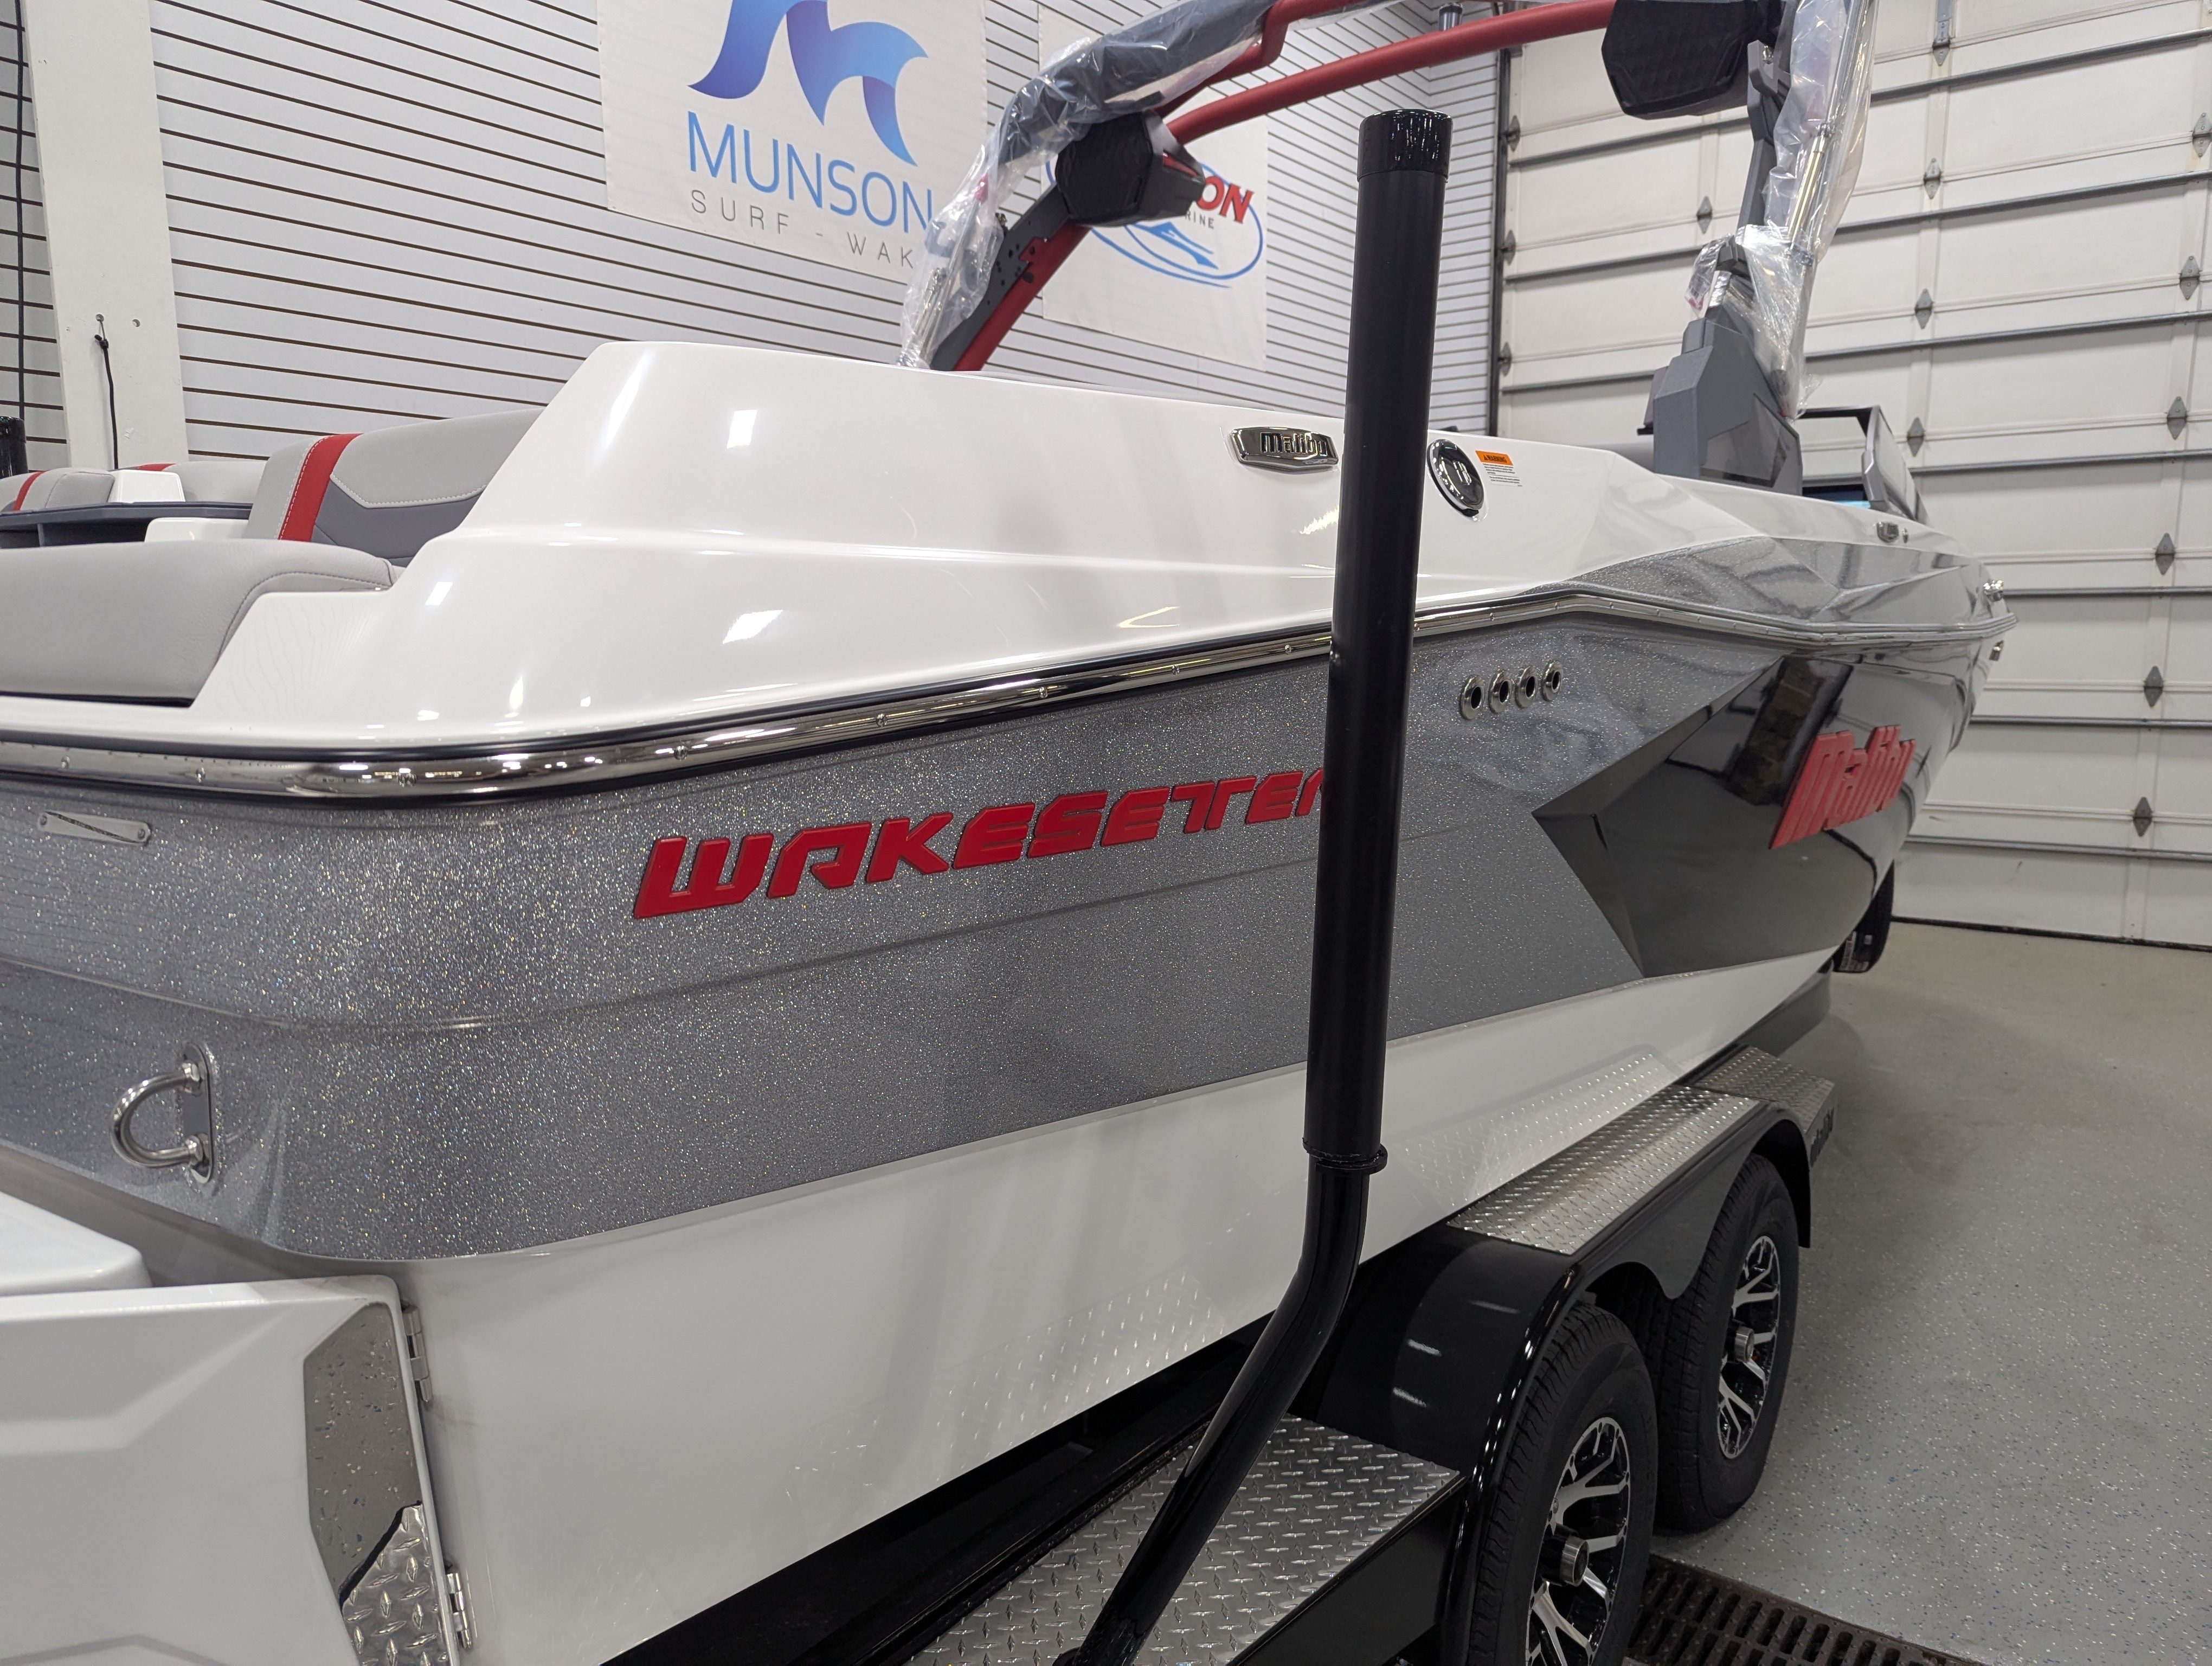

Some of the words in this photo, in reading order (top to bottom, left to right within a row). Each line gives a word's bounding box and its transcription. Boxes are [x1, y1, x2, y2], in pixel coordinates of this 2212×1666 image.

[688, 111, 932, 233] MUNSON
[691, 190, 789, 234] SURF
[847, 232, 913, 269] WAK
[1185, 210, 1214, 229] RINE
